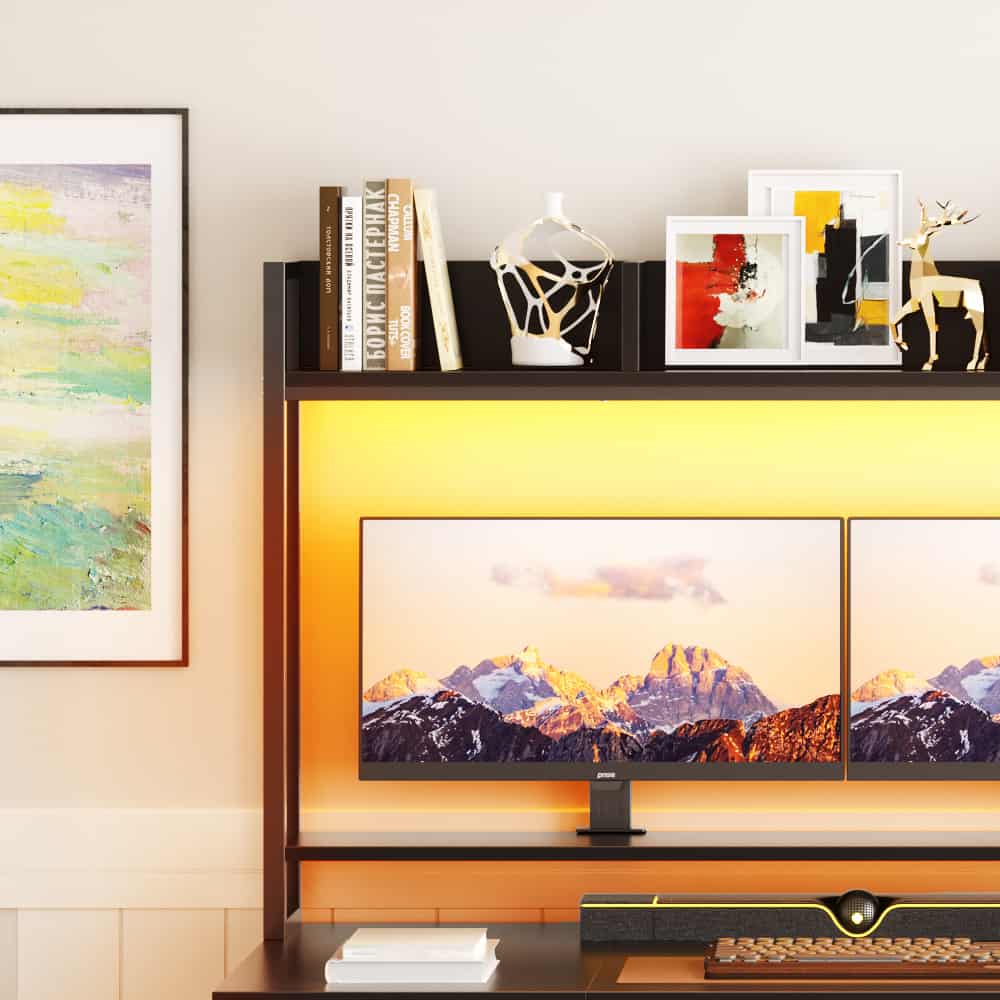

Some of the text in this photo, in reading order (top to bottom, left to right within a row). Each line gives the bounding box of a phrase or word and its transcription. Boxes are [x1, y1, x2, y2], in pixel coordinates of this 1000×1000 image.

[366, 189, 385, 359] БОРИС ПАСТЕРНАК
[388, 193, 400, 252] CHAPMAN
